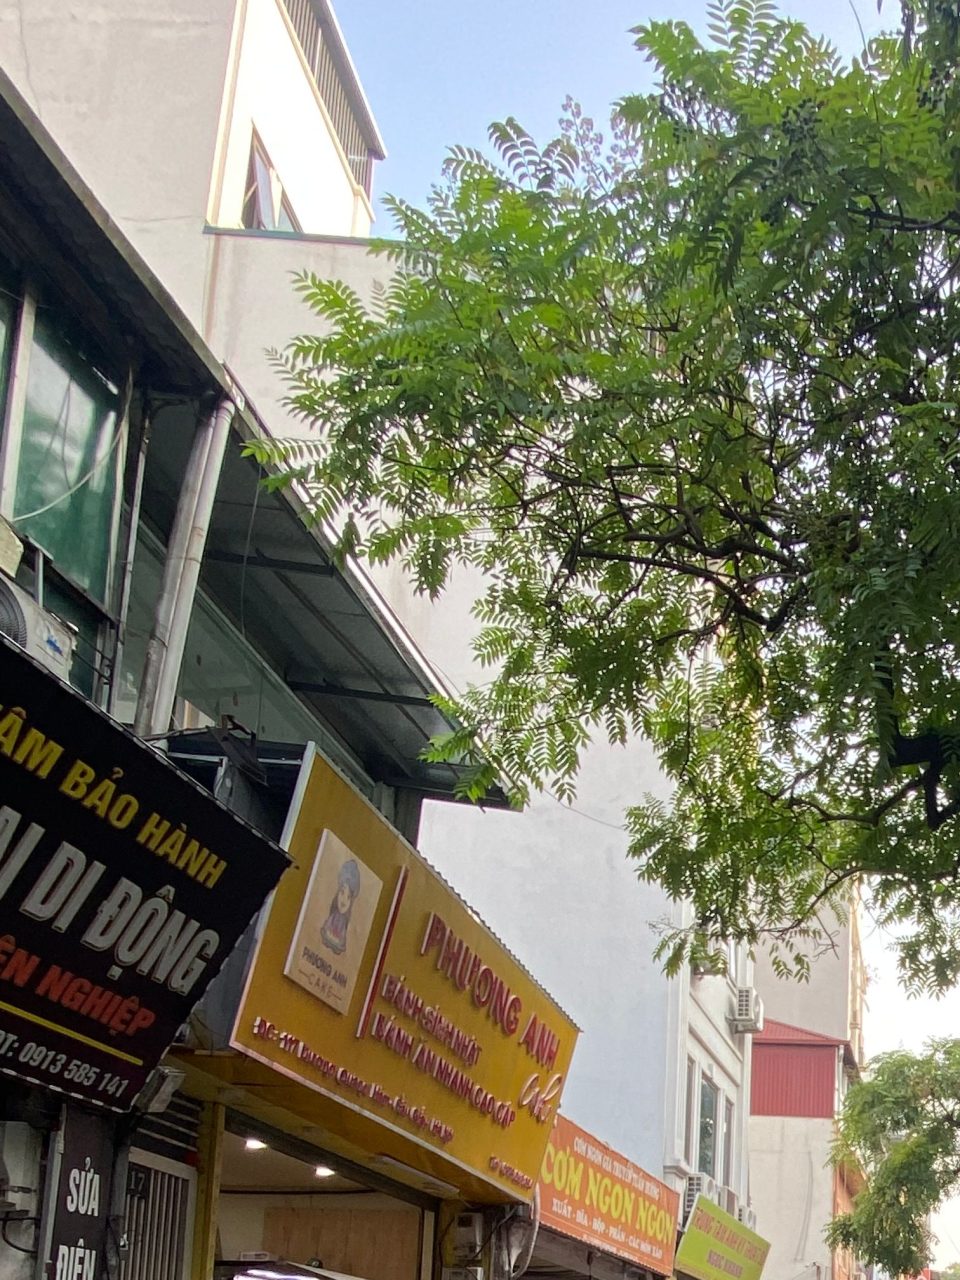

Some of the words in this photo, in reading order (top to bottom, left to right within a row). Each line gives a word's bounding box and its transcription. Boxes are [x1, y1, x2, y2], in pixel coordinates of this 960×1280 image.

[58, 759, 139, 829] BẢO
[136, 812, 227, 889] HÀNH
[19, 841, 106, 933] DI
[80, 876, 220, 997] ĐỘNG
[35, 965, 156, 1037] NGHIỆP
[18, 1042, 67, 1074] 0913
[63, 1060, 101, 1087] 585
[98, 1073, 130, 1099] 141
[518, 1012, 561, 1072] ANH
[67, 1157, 99, 1217] SỬA
[541, 1142, 584, 1200] CƠM
[585, 1168, 635, 1226] NGON
[635, 1197, 674, 1245] NGON
